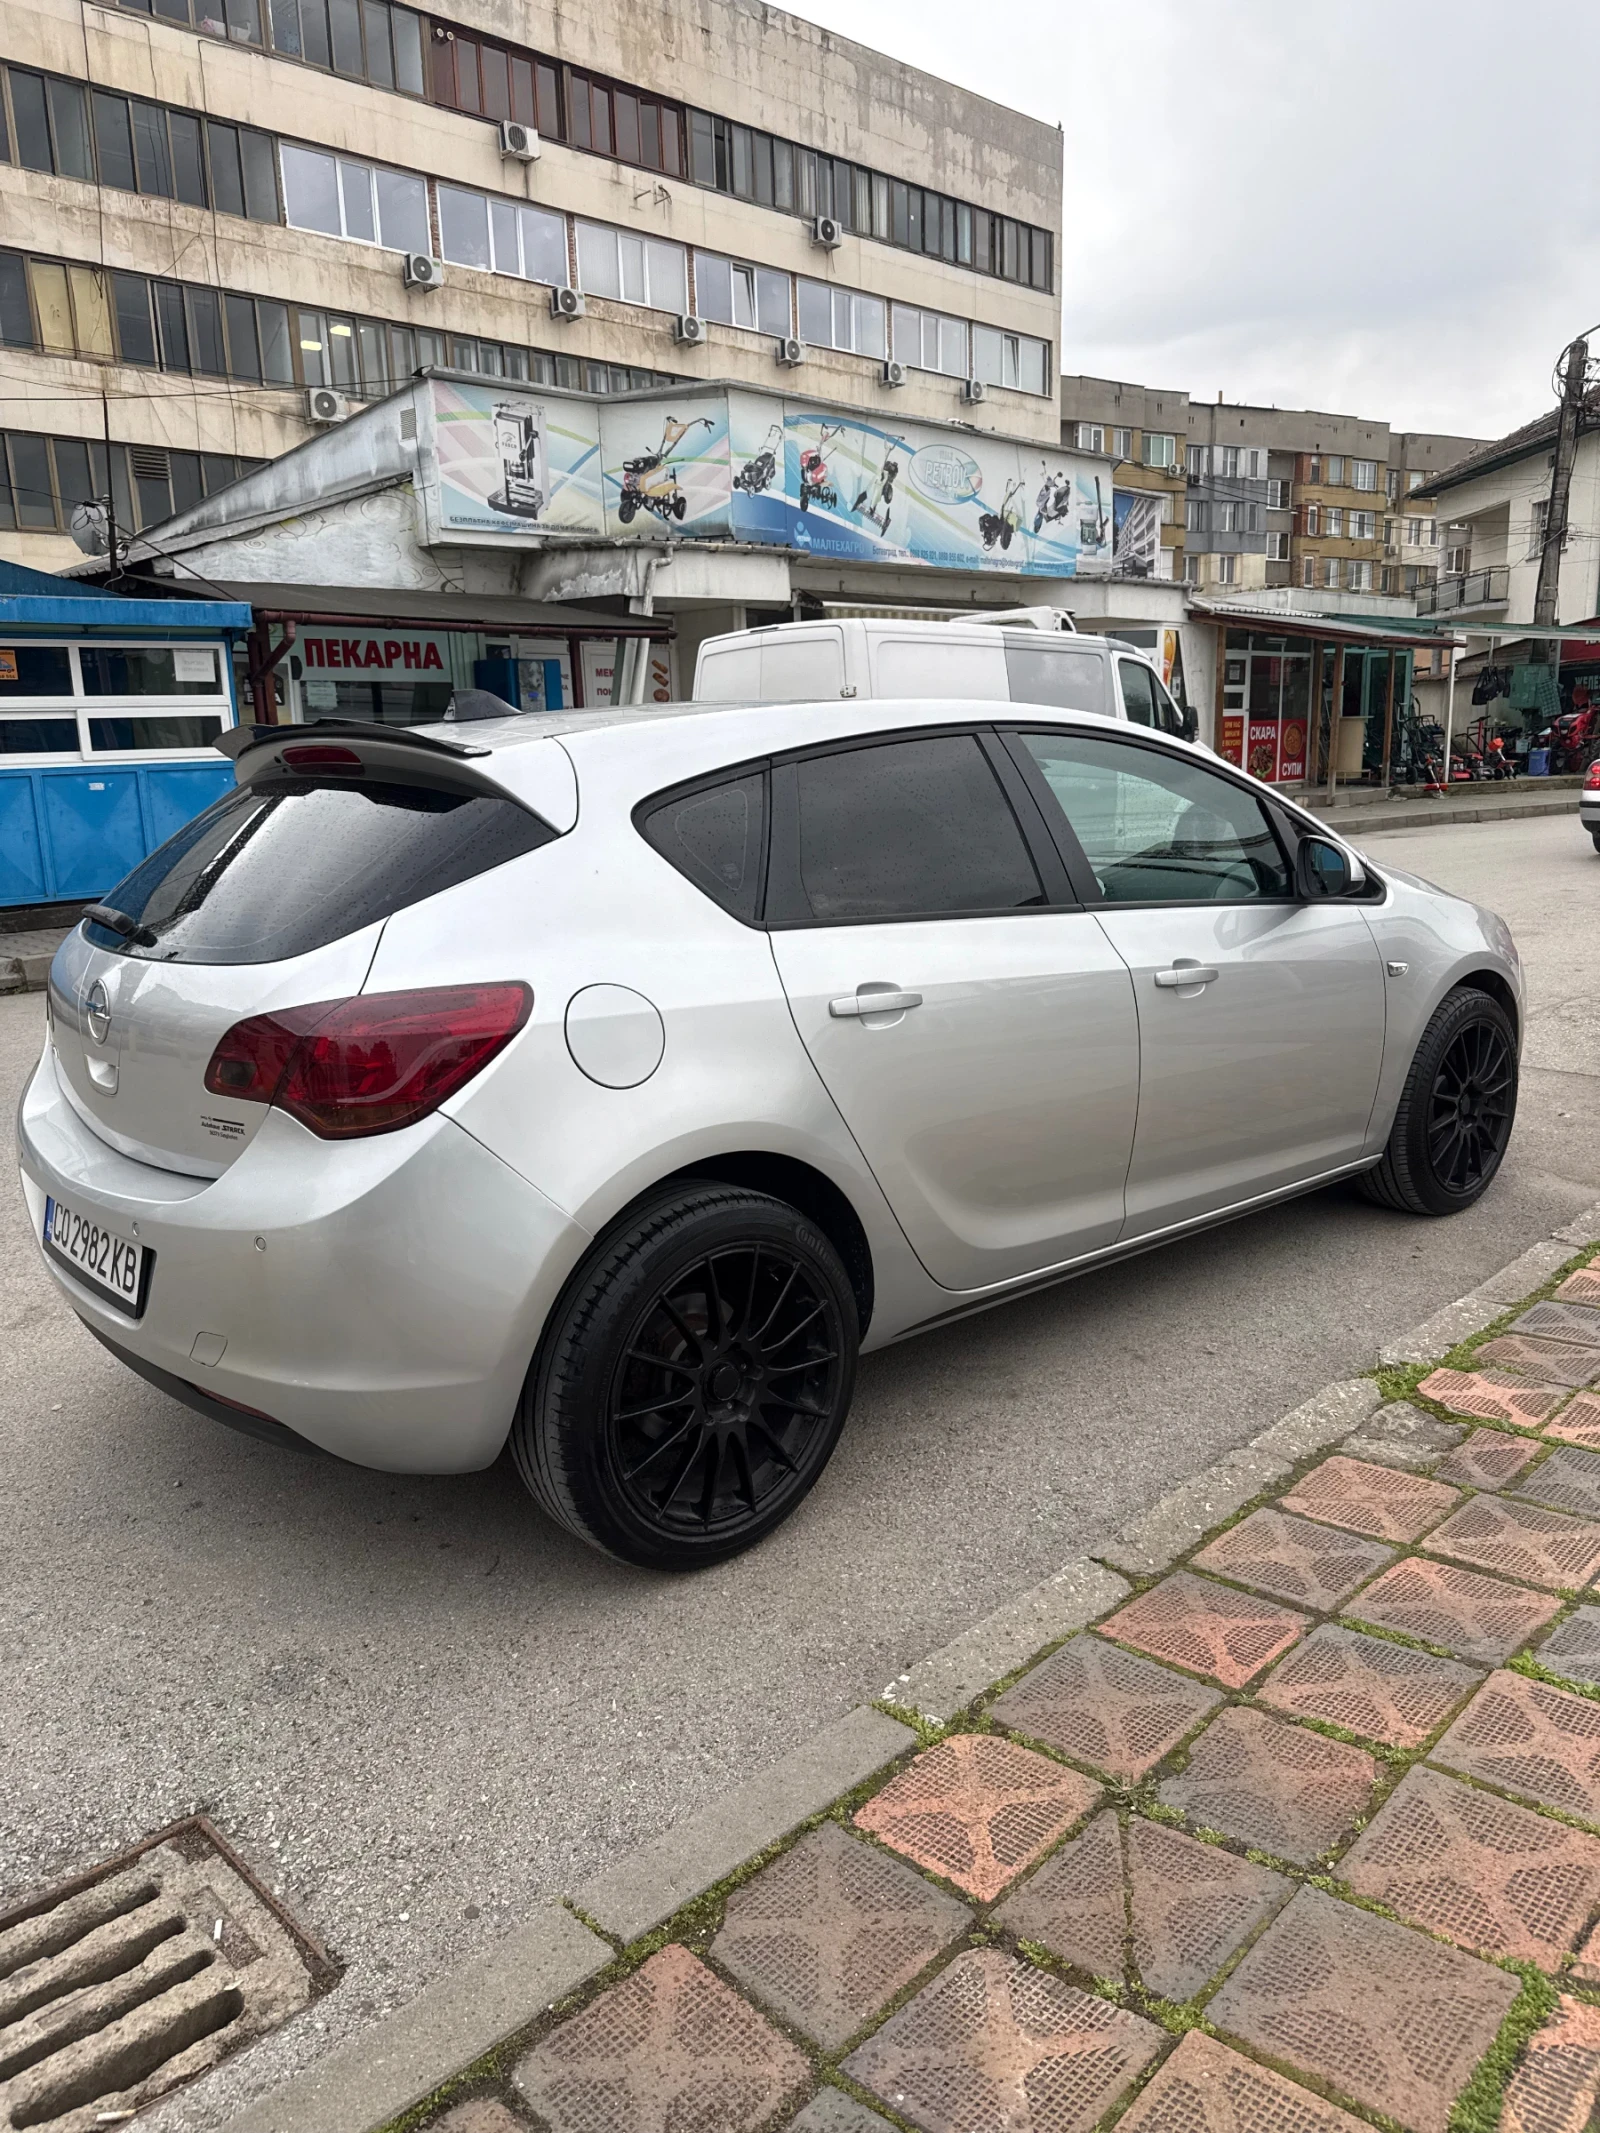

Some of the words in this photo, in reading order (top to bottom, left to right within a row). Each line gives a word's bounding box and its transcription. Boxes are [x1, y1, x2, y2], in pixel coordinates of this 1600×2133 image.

[925, 459, 967, 490] PETROV
[812, 537, 865, 553] МАЛТЕХАГРО
[303, 638, 444, 670] ПЕКАРНА
[1250, 726, 1276, 740] СКАРА
[1282, 763, 1302, 776] СУПИ
[221, 1124, 246, 1136] STRACK
[53, 1202, 137, 1294] CO2982KB
